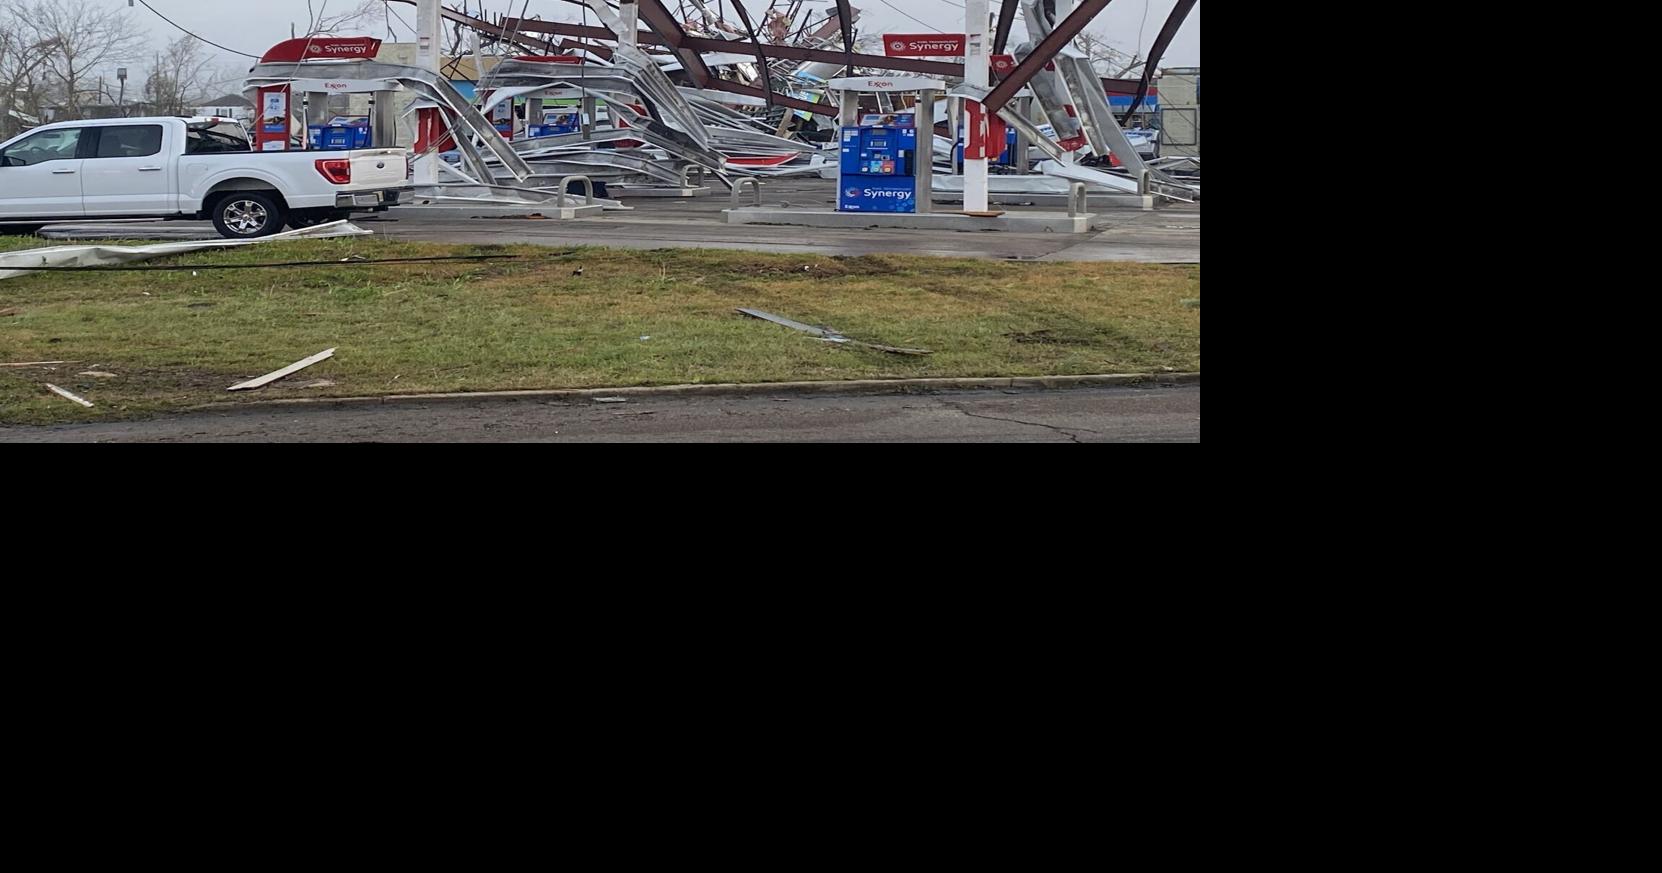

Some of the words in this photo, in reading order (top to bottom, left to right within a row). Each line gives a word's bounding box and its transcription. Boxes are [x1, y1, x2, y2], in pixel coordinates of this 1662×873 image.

[324, 45, 367, 54] Synergy
[909, 42, 959, 52] Synergy
[324, 82, 347, 90] Exxon
[867, 80, 894, 89] Exxon
[863, 188, 912, 200] Synergy
